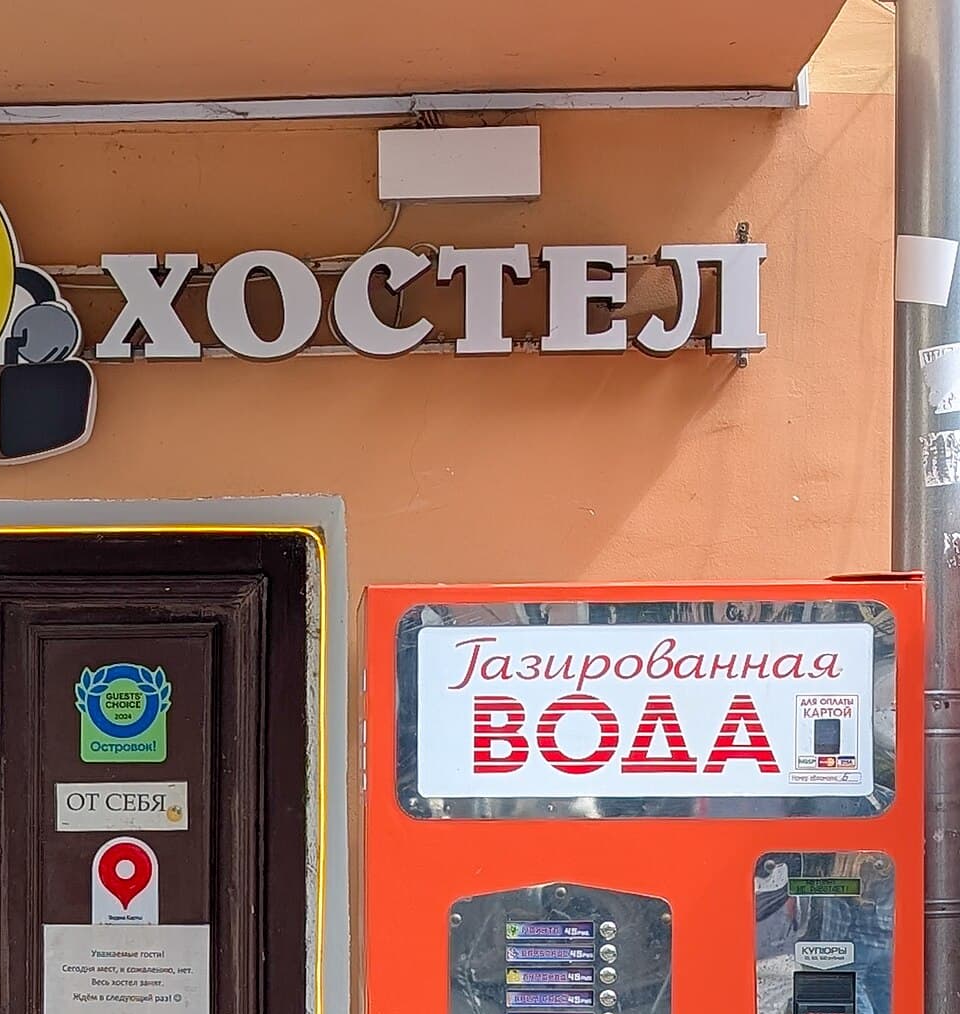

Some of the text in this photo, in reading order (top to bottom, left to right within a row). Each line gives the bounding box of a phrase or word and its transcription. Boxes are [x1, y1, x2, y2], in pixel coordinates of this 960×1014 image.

[95, 243, 768, 360] ХОСТЕЛ
[448, 637, 843, 691] Газированная
[105, 701, 141, 709] CHOICE
[800, 698, 854, 706] ДЛЯ ОПЛАТЫ
[803, 706, 852, 718] КАРТОЙ
[473, 693, 781, 775] ВОДА
[90, 740, 157, 754] Островок!
[66, 792, 167, 812] ОТ СЕБЯ
[90, 949, 165, 959] Уважаемые гости!
[801, 946, 847, 955] КУПЮРЫ
[62, 964, 96, 974] Сегодня
[91, 978, 110, 987] Весь
[111, 979, 138, 987] хостел
[73, 992, 98, 1002] Ждём
[106, 993, 153, 1002] следующий
[155, 994, 172, 1002] раз!
